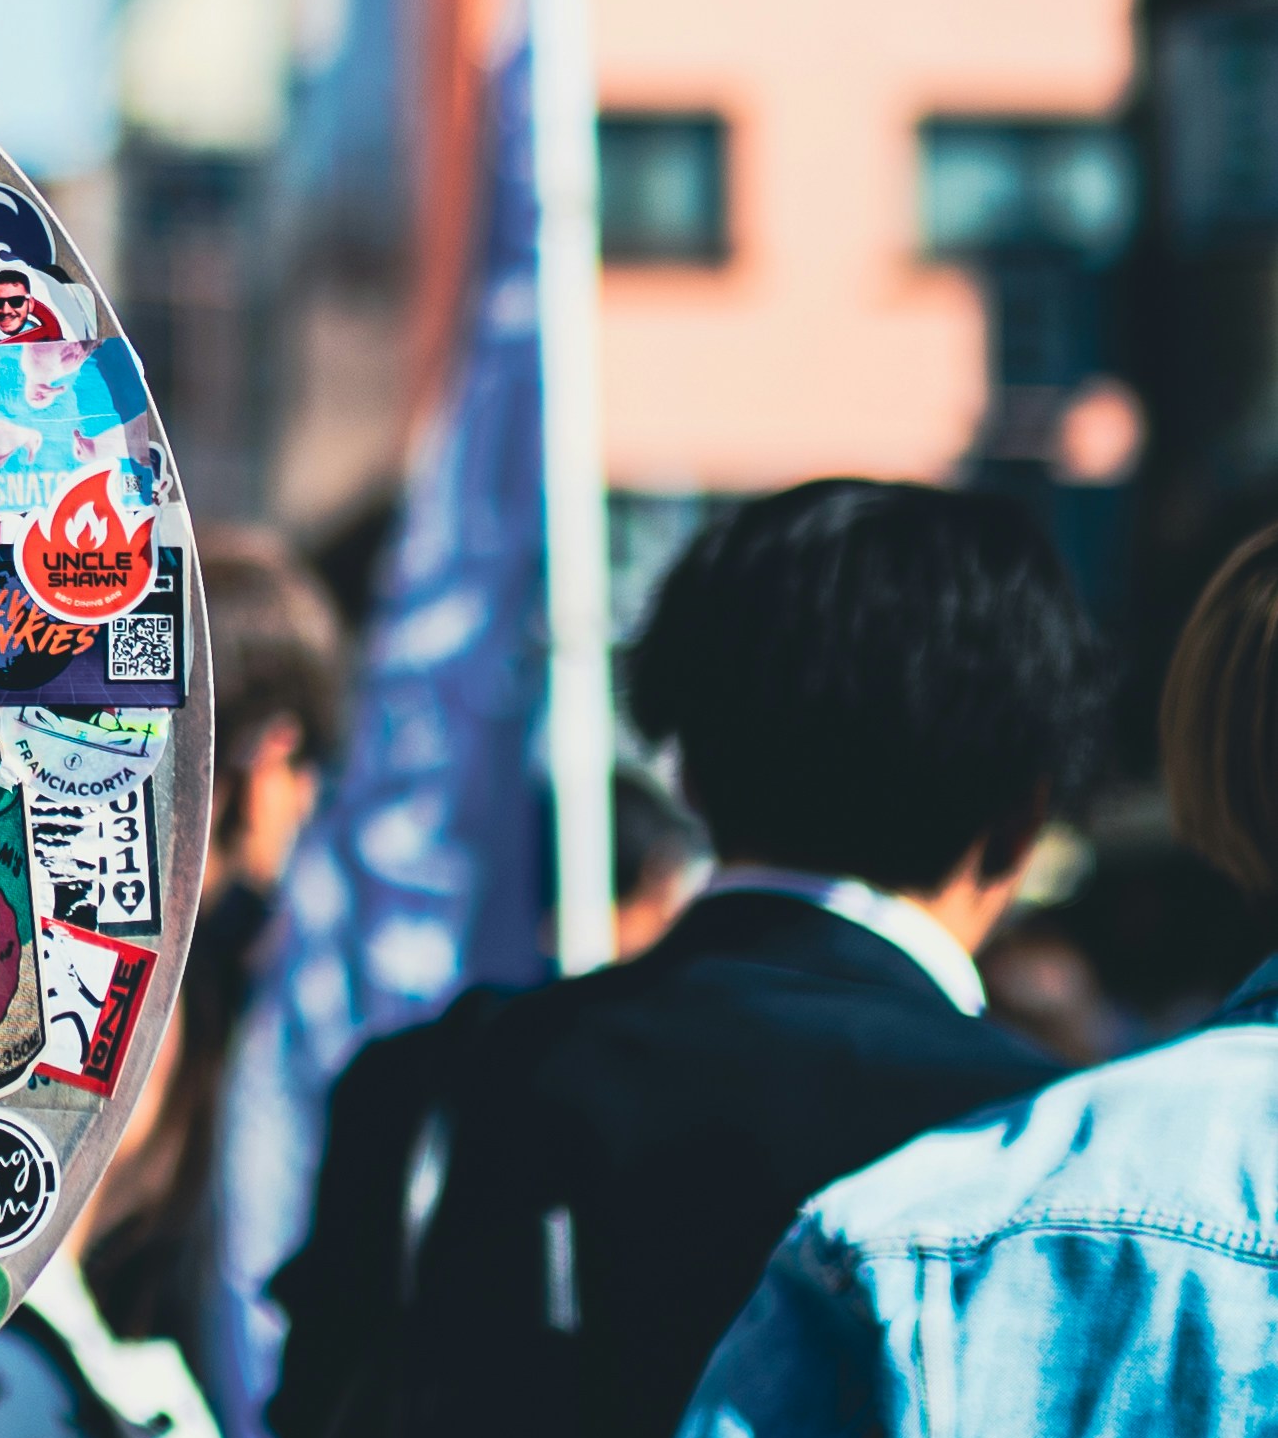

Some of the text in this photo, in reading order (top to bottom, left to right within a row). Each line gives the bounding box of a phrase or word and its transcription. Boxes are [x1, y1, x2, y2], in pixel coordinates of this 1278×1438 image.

[42, 552, 132, 572] UNCLE
[47, 571, 128, 588] SHAWN
[14, 739, 137, 797] FRANCIACORTA
